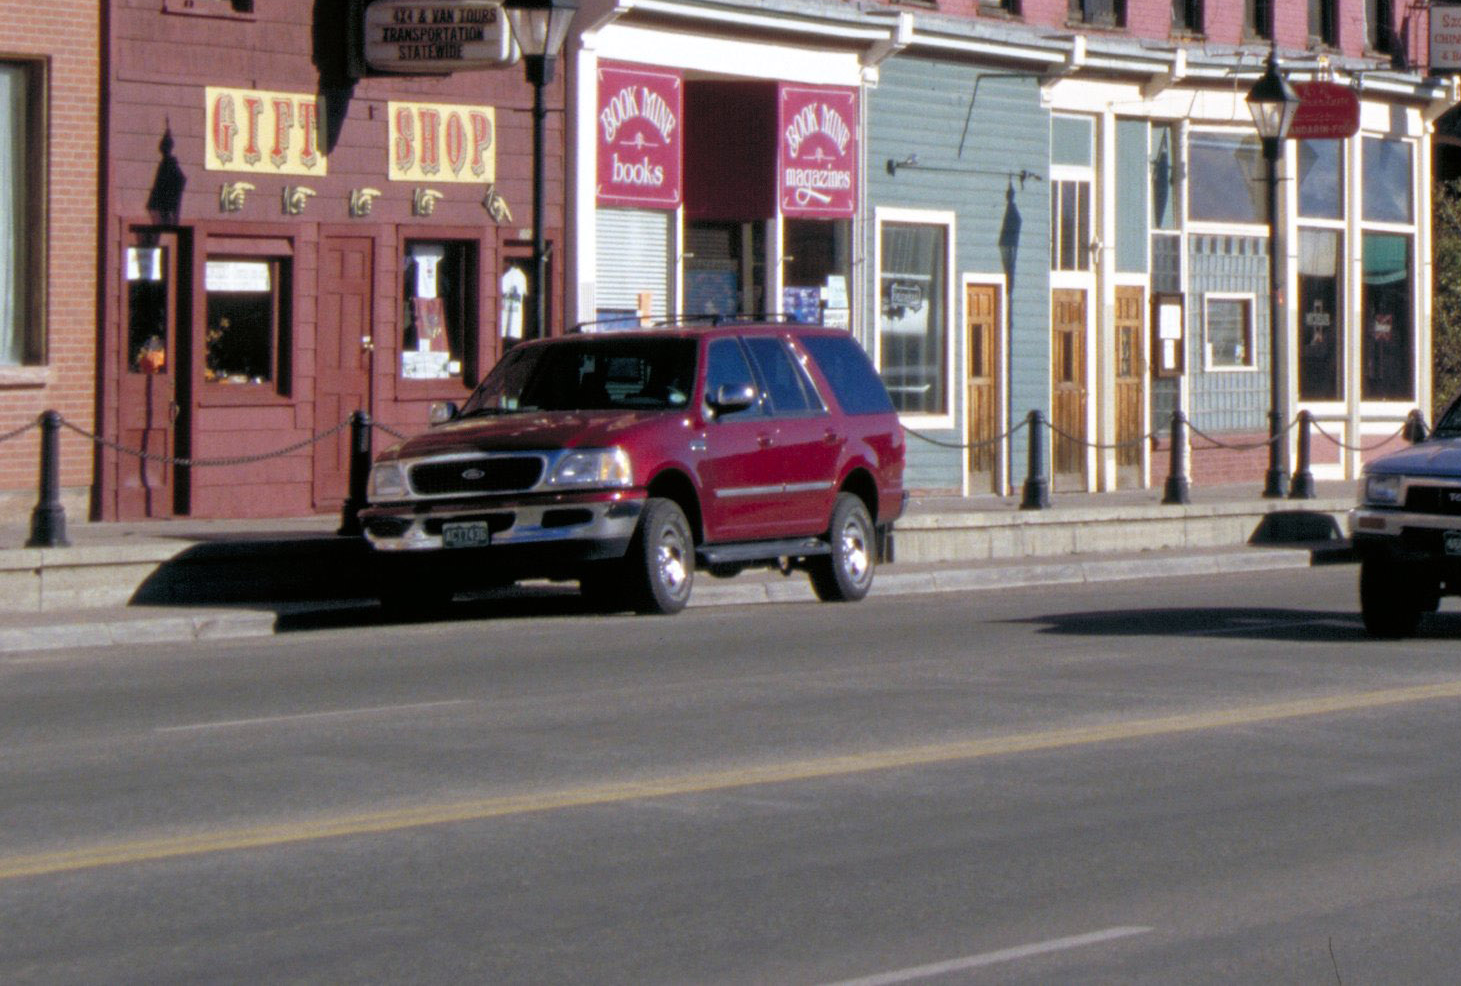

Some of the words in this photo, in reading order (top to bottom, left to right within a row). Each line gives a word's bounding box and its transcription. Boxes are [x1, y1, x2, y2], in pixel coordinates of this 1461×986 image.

[382, 26, 485, 42] TRANSPORTATION
[432, 7, 455, 24] VAN
[459, 7, 498, 24] TOURS
[398, 43, 464, 60] STATEWIDE
[600, 85, 640, 144] BOOK
[642, 86, 677, 144] MINE
[785, 102, 820, 158] BOOK
[821, 103, 851, 157] MINE
[212, 93, 319, 169] GIFT
[395, 106, 491, 177] SHOP
[612, 152, 664, 186] books
[786, 163, 850, 205] magazines
